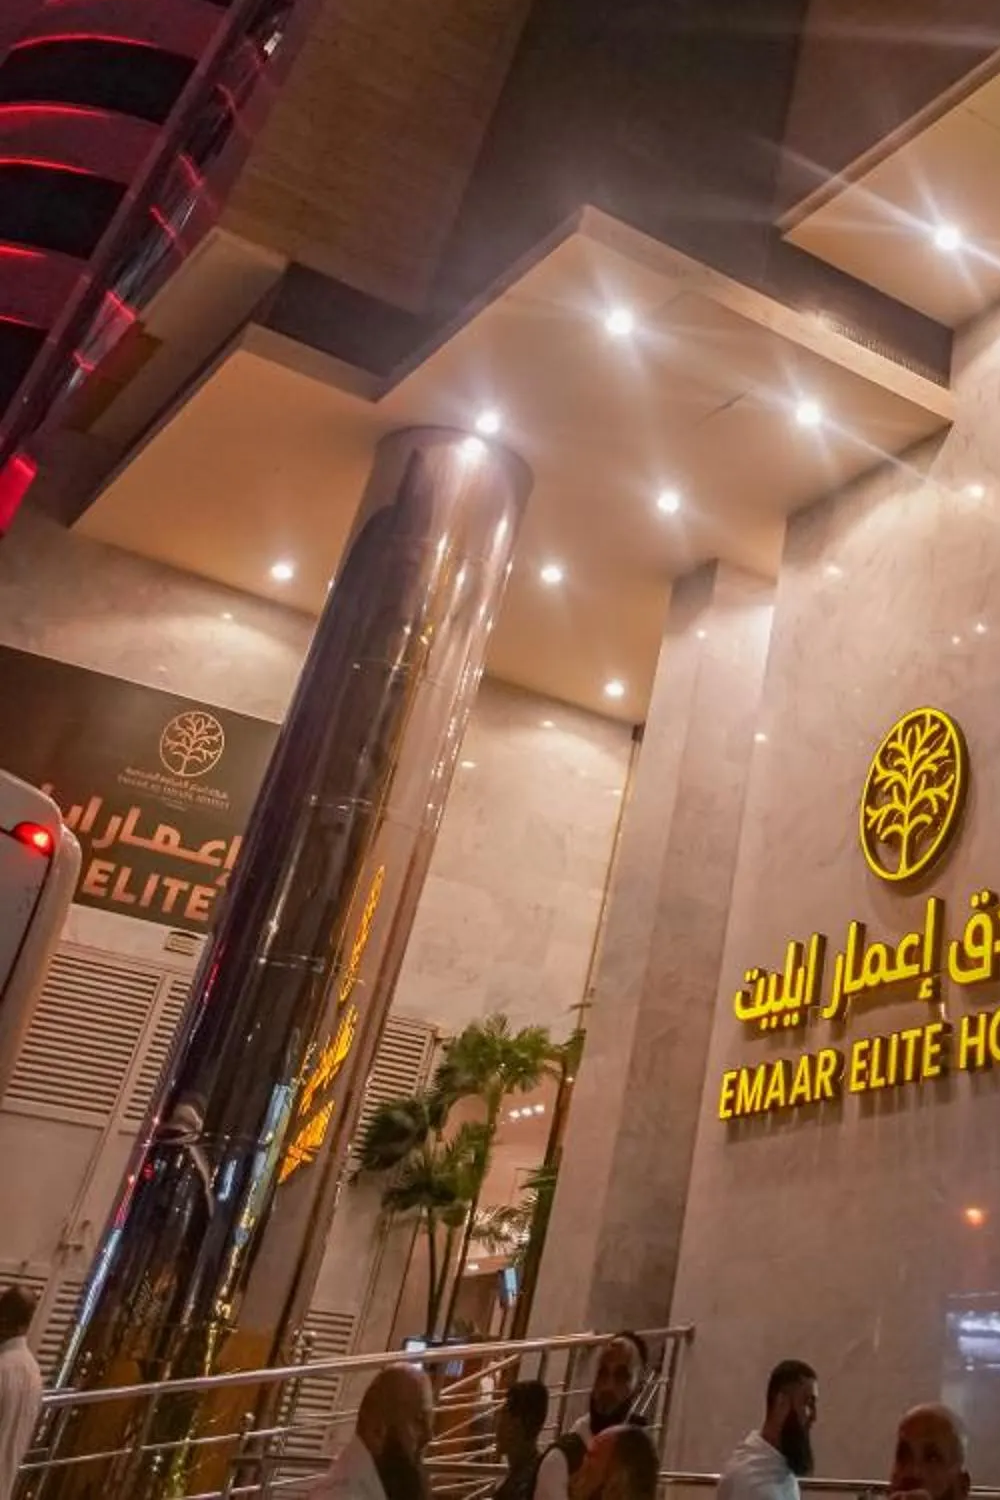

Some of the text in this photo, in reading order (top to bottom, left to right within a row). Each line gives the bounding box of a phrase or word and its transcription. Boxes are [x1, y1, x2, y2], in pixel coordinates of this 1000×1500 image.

[84, 859, 216, 920] ELITE
[718, 1048, 838, 1120] EMAAR
[849, 1022, 943, 1093] ELITE
